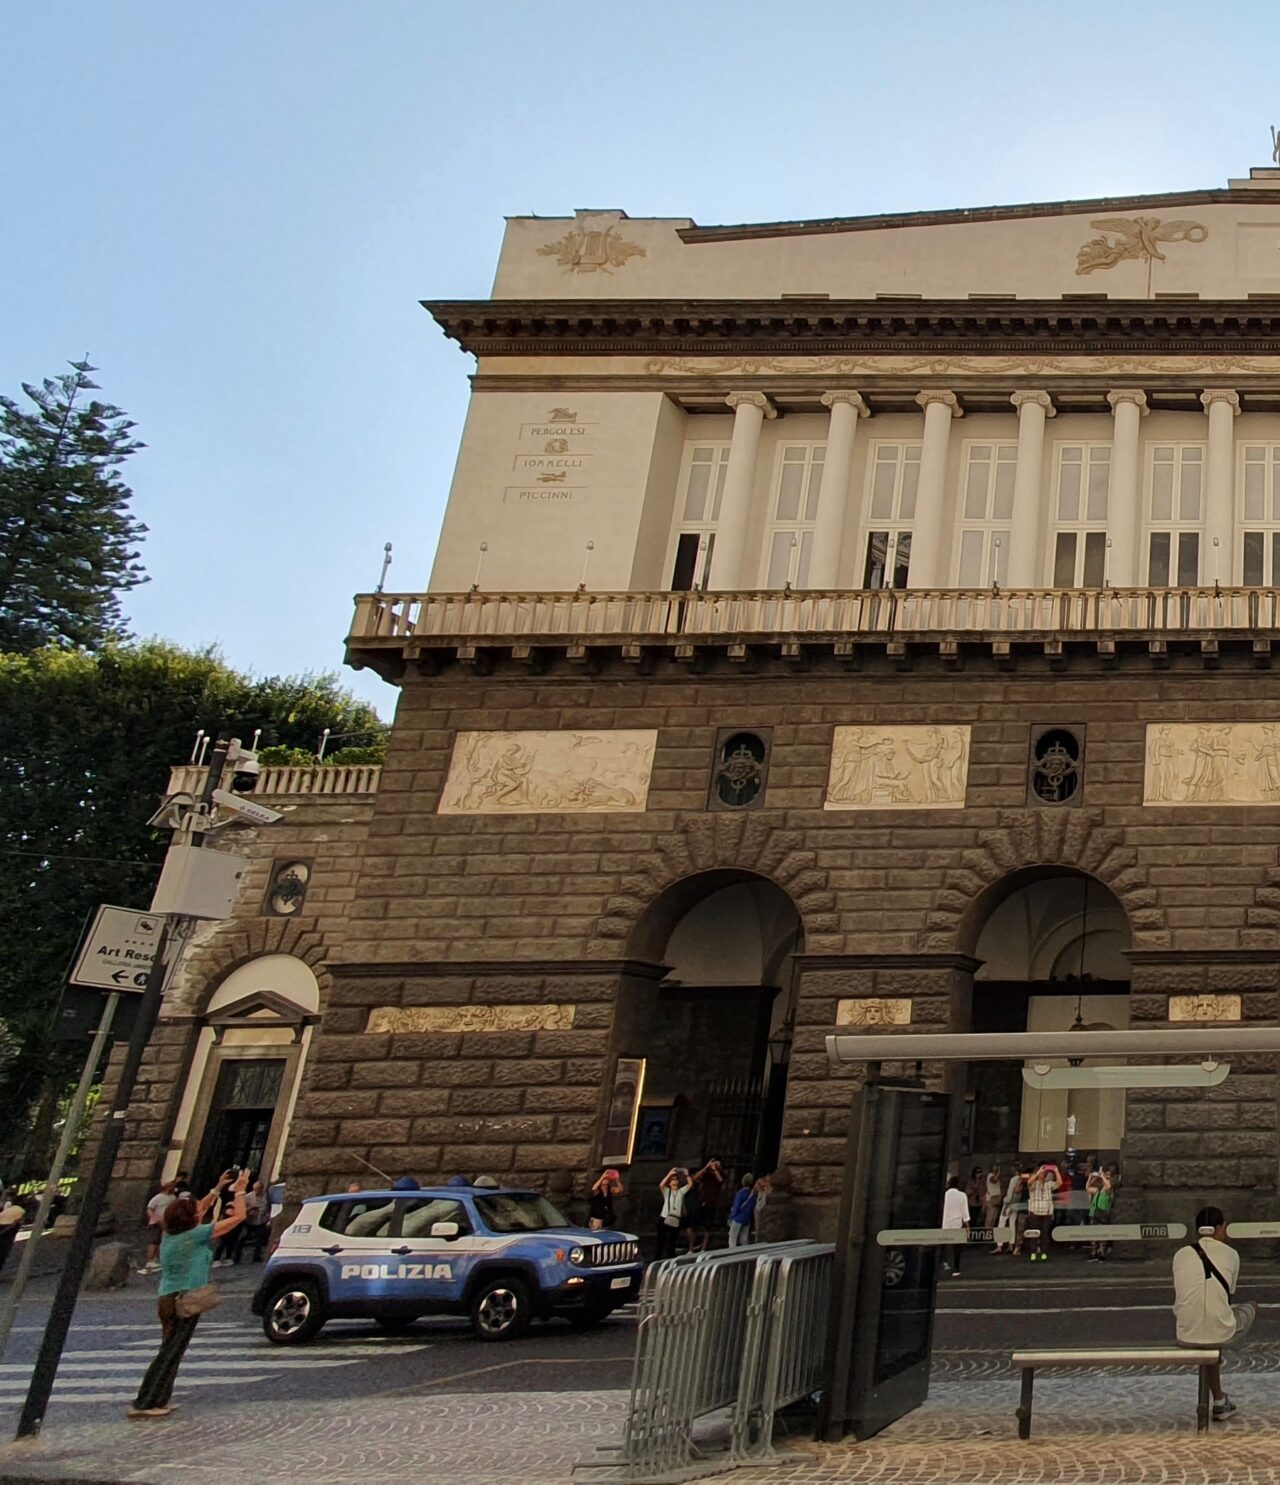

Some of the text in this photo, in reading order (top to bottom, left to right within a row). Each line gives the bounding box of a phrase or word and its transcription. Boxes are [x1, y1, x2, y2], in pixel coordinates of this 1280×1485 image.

[530, 427, 586, 436] PERGOLESI
[518, 491, 574, 500] PICCINNI
[96, 945, 121, 957] Art
[341, 1264, 453, 1280] POLIZIA
